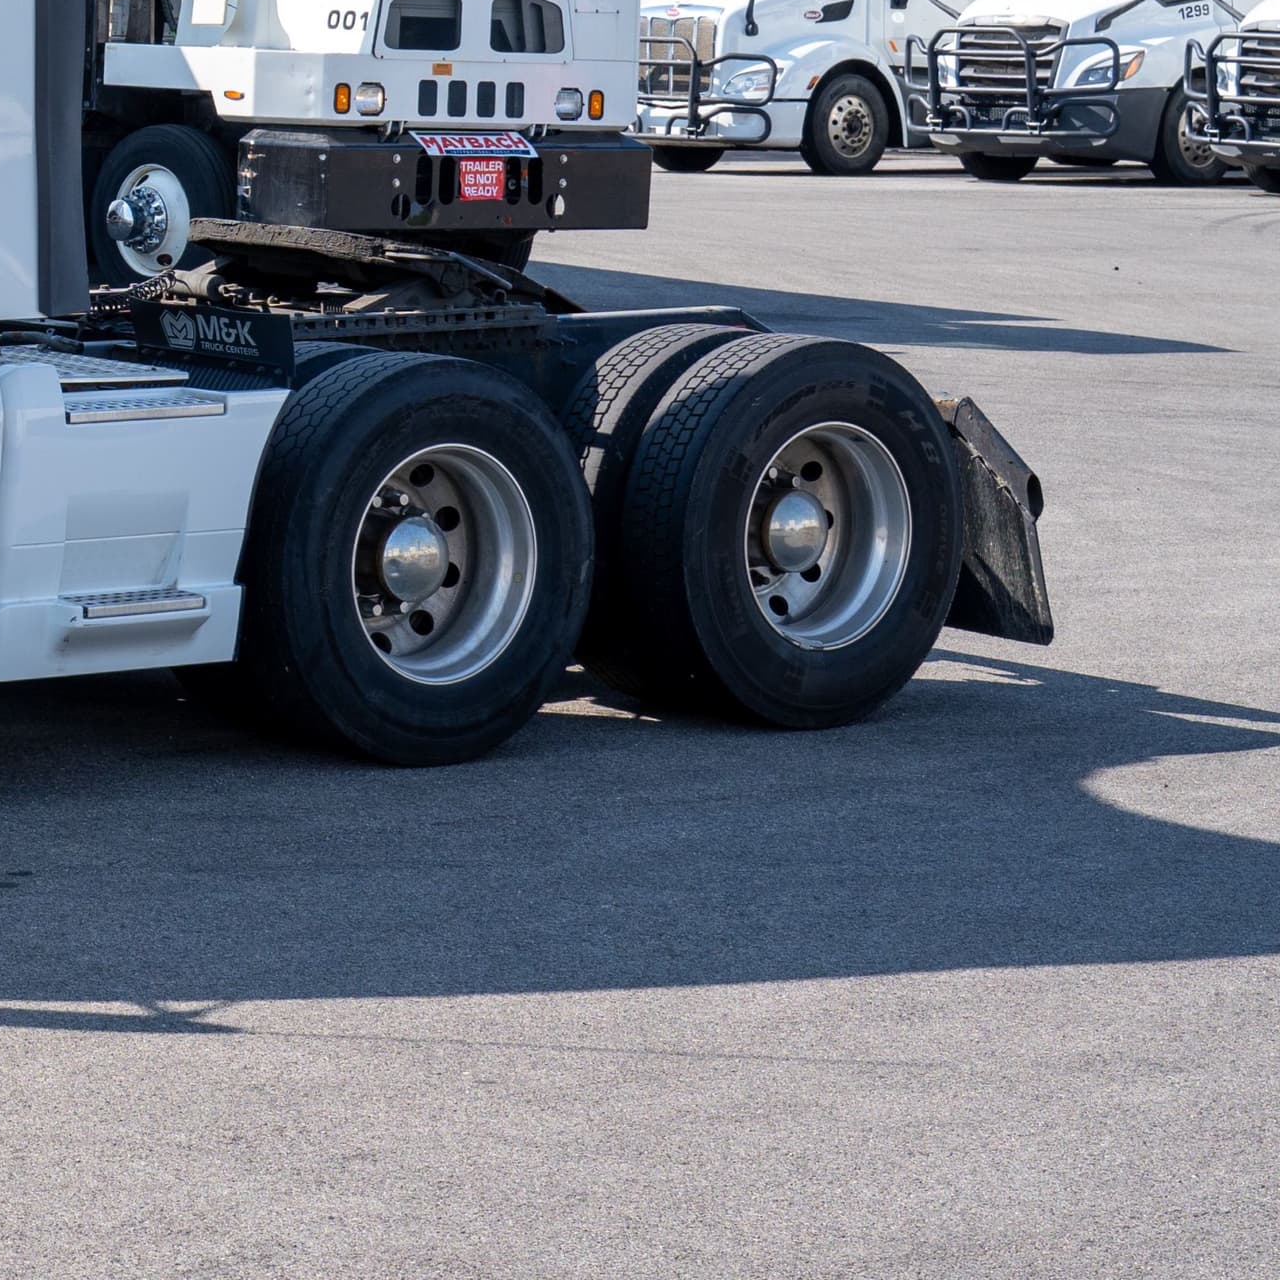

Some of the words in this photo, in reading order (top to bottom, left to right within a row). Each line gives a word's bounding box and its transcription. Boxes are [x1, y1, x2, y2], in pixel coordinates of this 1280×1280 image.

[1178, 3, 1210, 20] 1299
[418, 131, 529, 155] MAYBACH
[460, 160, 503, 172] TRAILER
[465, 173, 475, 185] IS
[476, 173, 498, 184] NOT
[464, 186, 499, 197] READY
[195, 313, 257, 346] M&K
[200, 340, 224, 352] TRUCK
[225, 345, 260, 357] CENTERS
